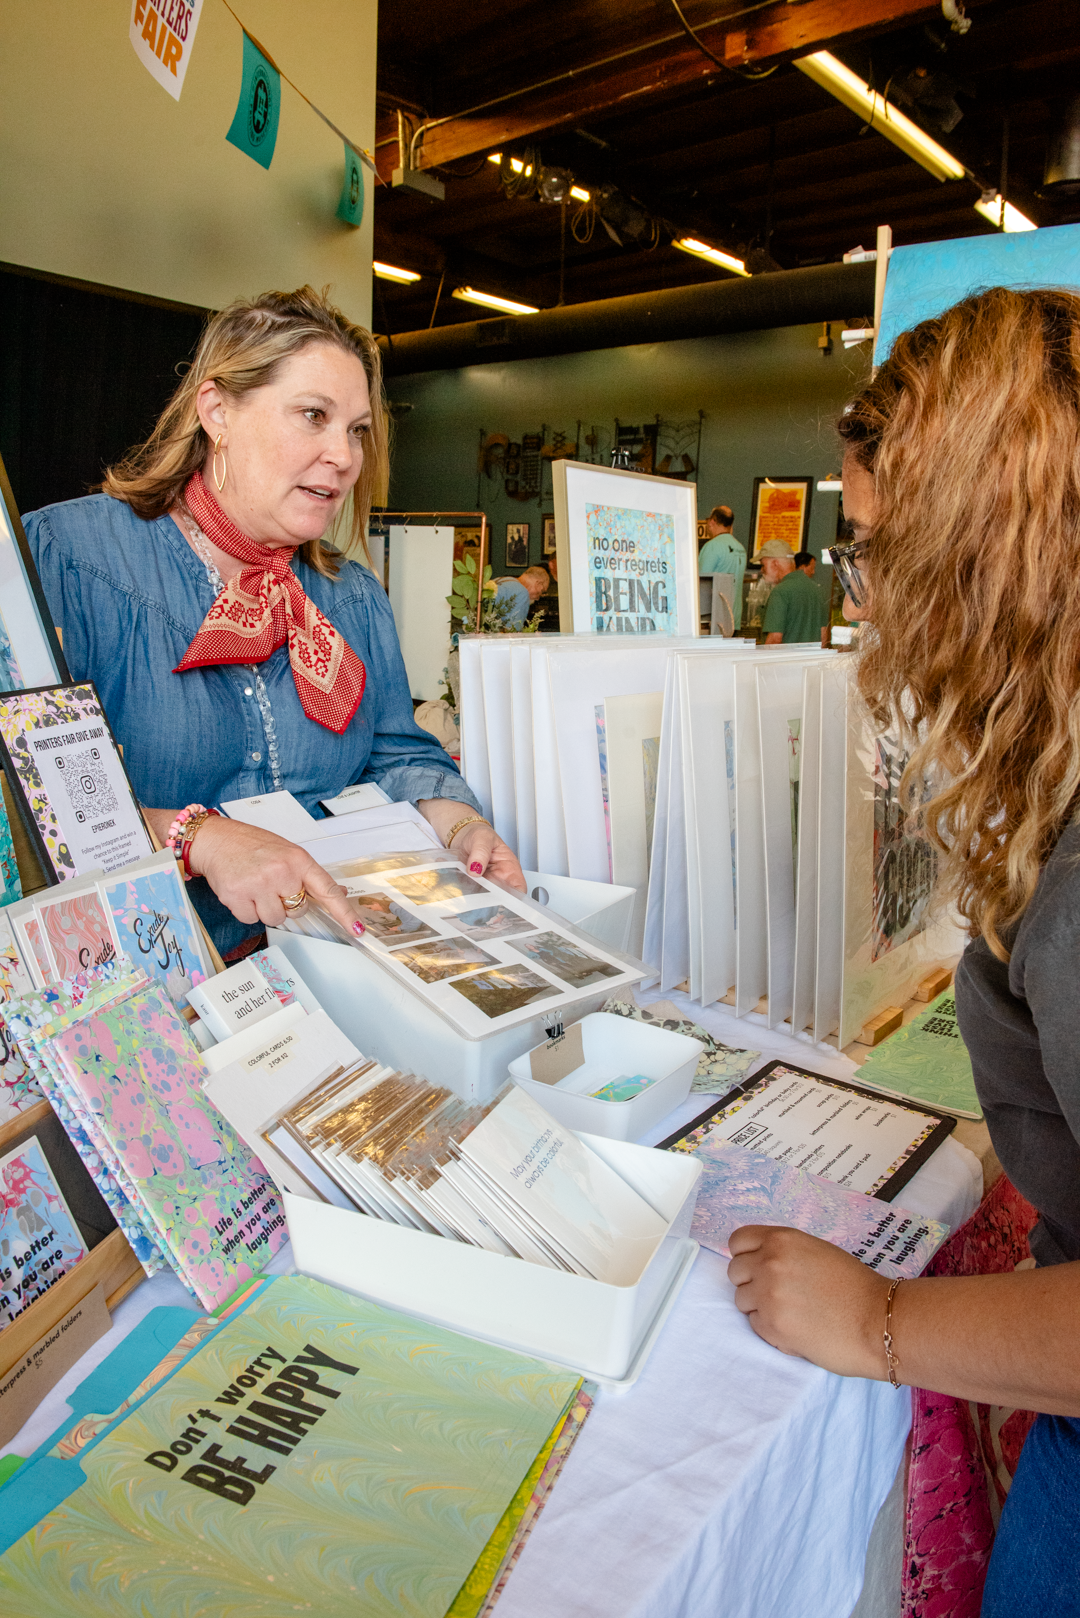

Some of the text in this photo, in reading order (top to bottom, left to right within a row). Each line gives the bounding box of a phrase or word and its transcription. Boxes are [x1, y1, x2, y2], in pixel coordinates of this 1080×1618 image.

[134, 0, 183, 77] FAIR
[593, 536, 636, 553] no one
[594, 556, 667, 575] ever regrets
[595, 576, 668, 614] BEING
[33, 727, 105, 752] PRINTERS FAIR GIVE AWAY
[81, 847, 95, 855] Follow
[101, 837, 120, 847] Instagram
[93, 851, 107, 860] chance
[154, 916, 185, 977] Joy
[222, 980, 256, 1004] the sun
[234, 1001, 253, 1020] and
[249, 993, 268, 1009] her
[247, 1050, 271, 1067] COLORFUL
[269, 1041, 284, 1053] CARDS
[272, 1057, 281, 1066] FOR
[743, 1126, 760, 1136] LIST
[509, 1164, 527, 1180] May
[214, 1182, 267, 1237] Life is better
[222, 1197, 277, 1256] when you are
[246, 1214, 287, 1254] laughing.
[861, 1239, 875, 1247] is
[868, 1212, 896, 1238] better
[865, 1218, 912, 1269] hen you are
[889, 1226, 929, 1265] laughing.
[12, 1230, 54, 1270] better
[12, 1249, 63, 1300] you are
[0, 1310, 83, 1398] terpress & marbled folders
[144, 1345, 288, 1473] Don't worry
[180, 1343, 360, 1507] BE HAPPY
